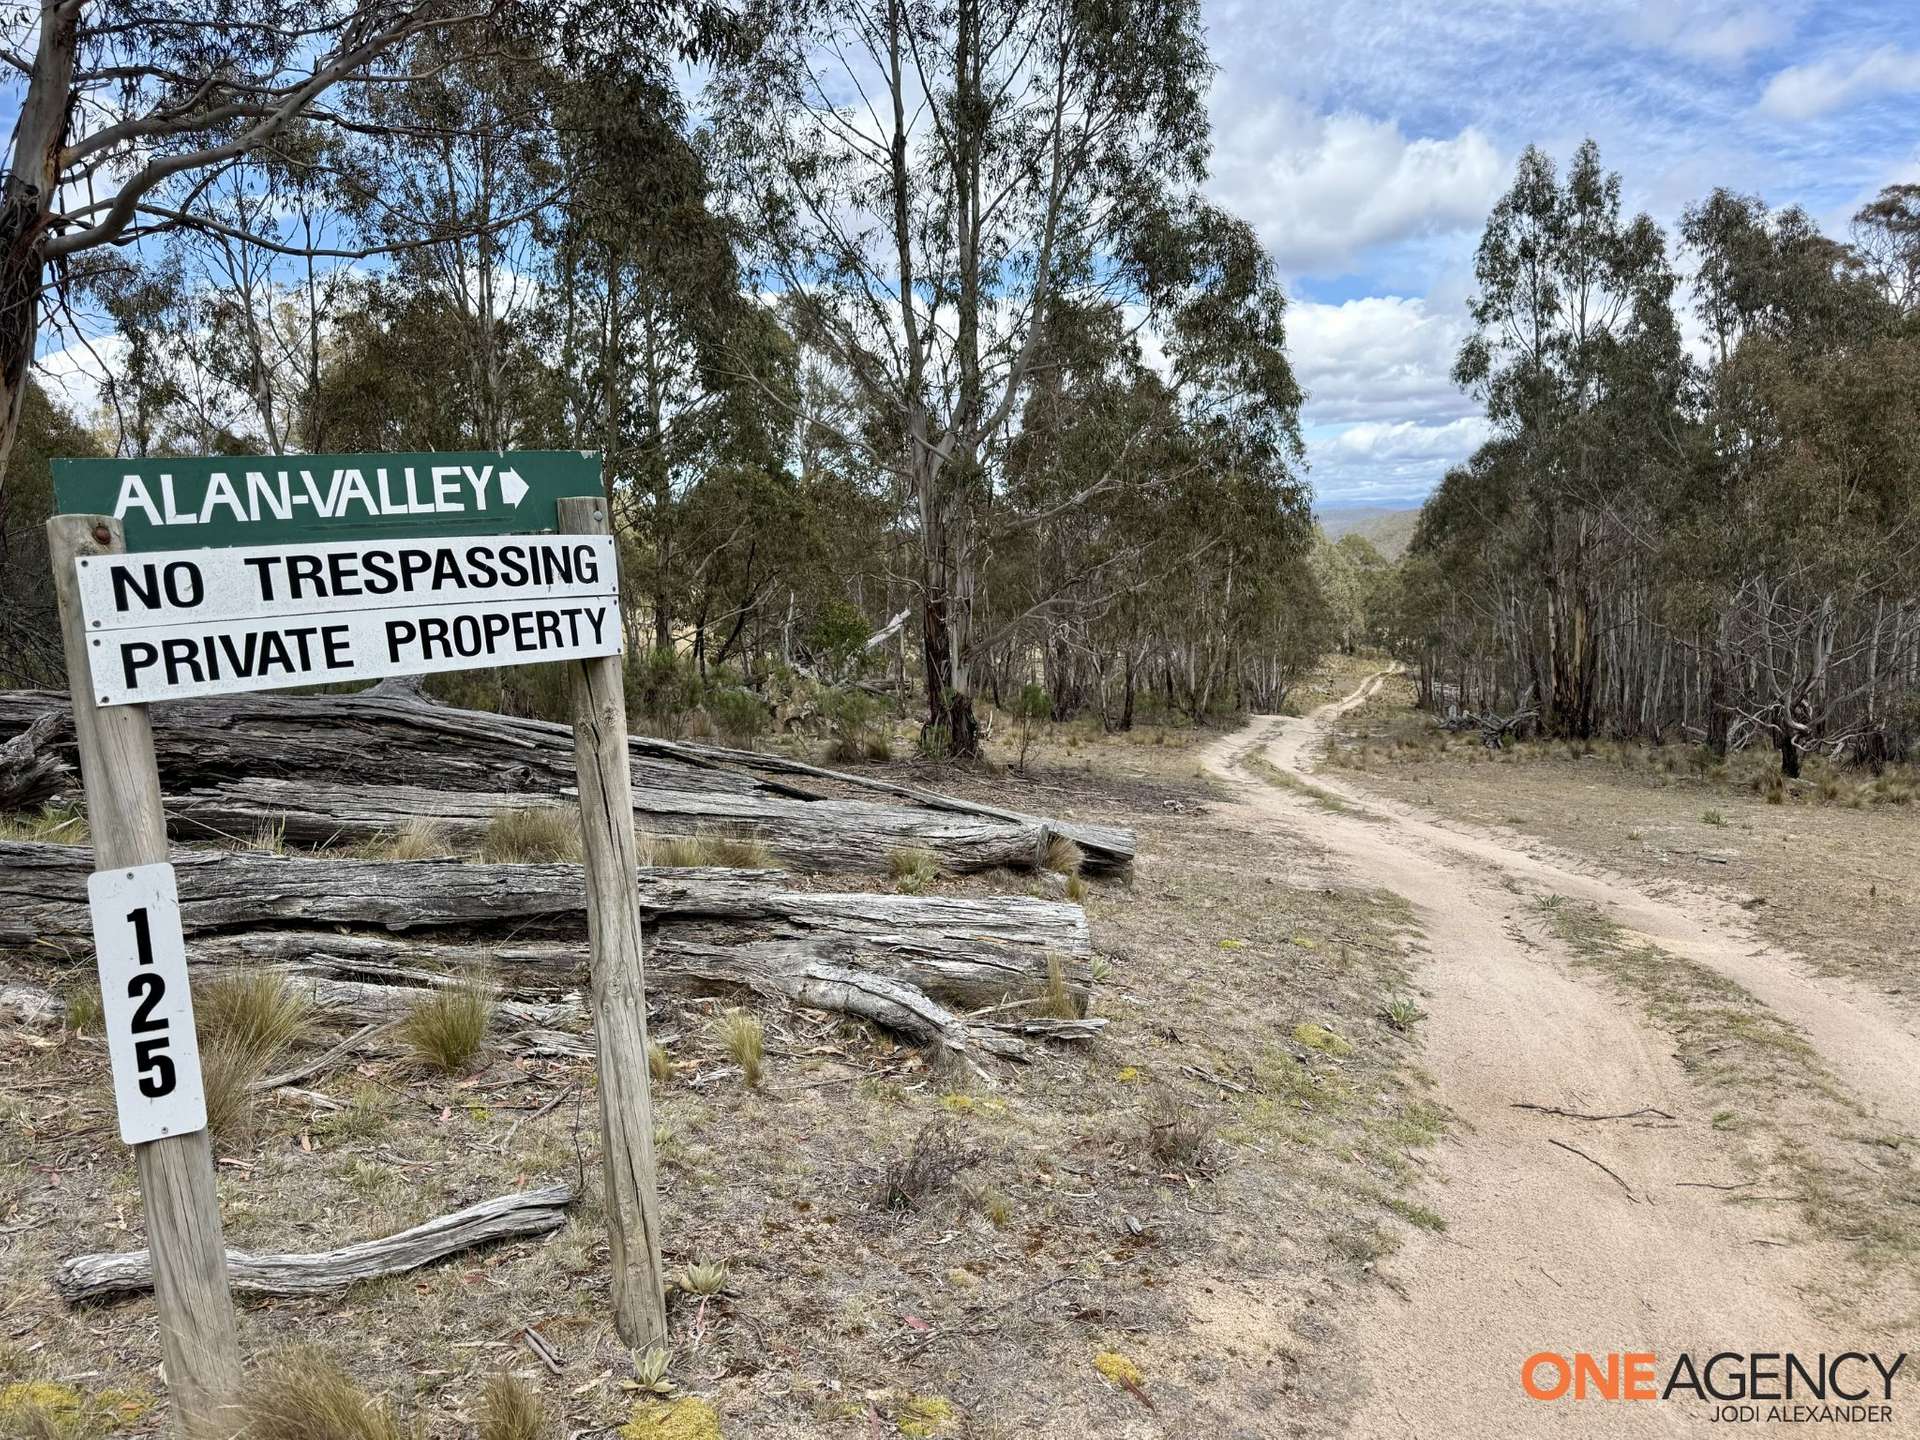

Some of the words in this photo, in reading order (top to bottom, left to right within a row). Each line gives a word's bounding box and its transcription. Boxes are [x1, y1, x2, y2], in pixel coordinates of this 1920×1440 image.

[113, 465, 494, 525] ALAN-VALLEY
[111, 561, 203, 612] NO
[244, 544, 598, 601] TRESPASSING
[120, 624, 354, 689] PRIVATE
[386, 607, 606, 663] PROPERTY
[126, 907, 177, 1098] 125
